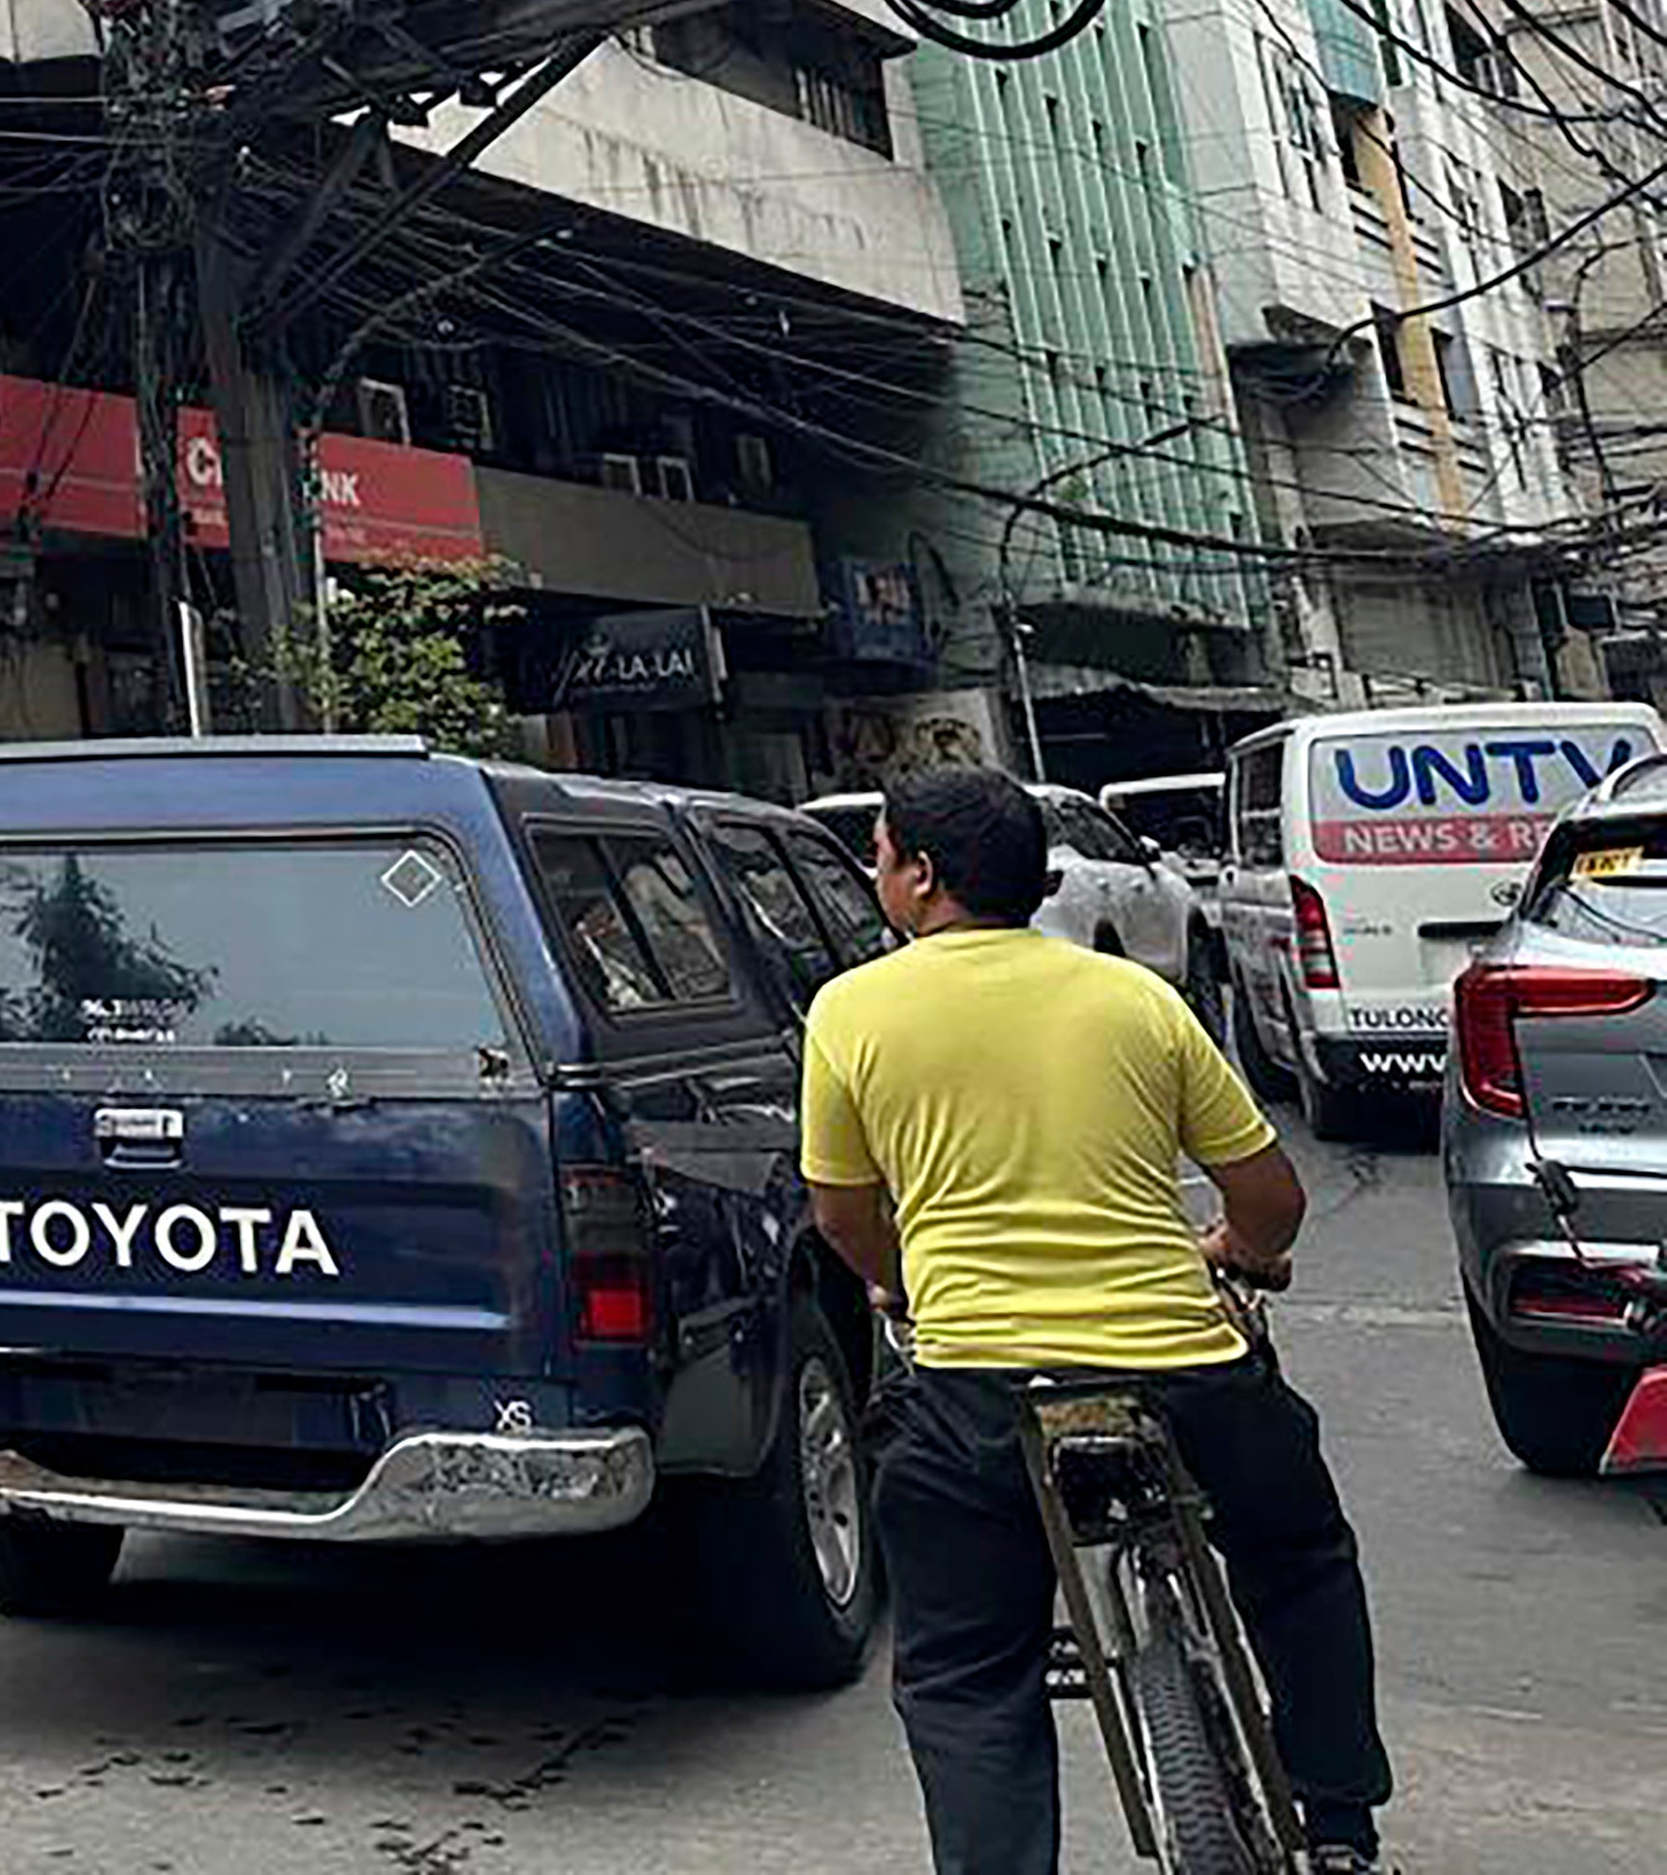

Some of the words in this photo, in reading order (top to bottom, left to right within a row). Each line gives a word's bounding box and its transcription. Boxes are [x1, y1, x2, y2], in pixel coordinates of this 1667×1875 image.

[1334, 738, 1632, 811] UNTV
[1344, 823, 1456, 854] NEWS
[1469, 824, 1498, 849] &
